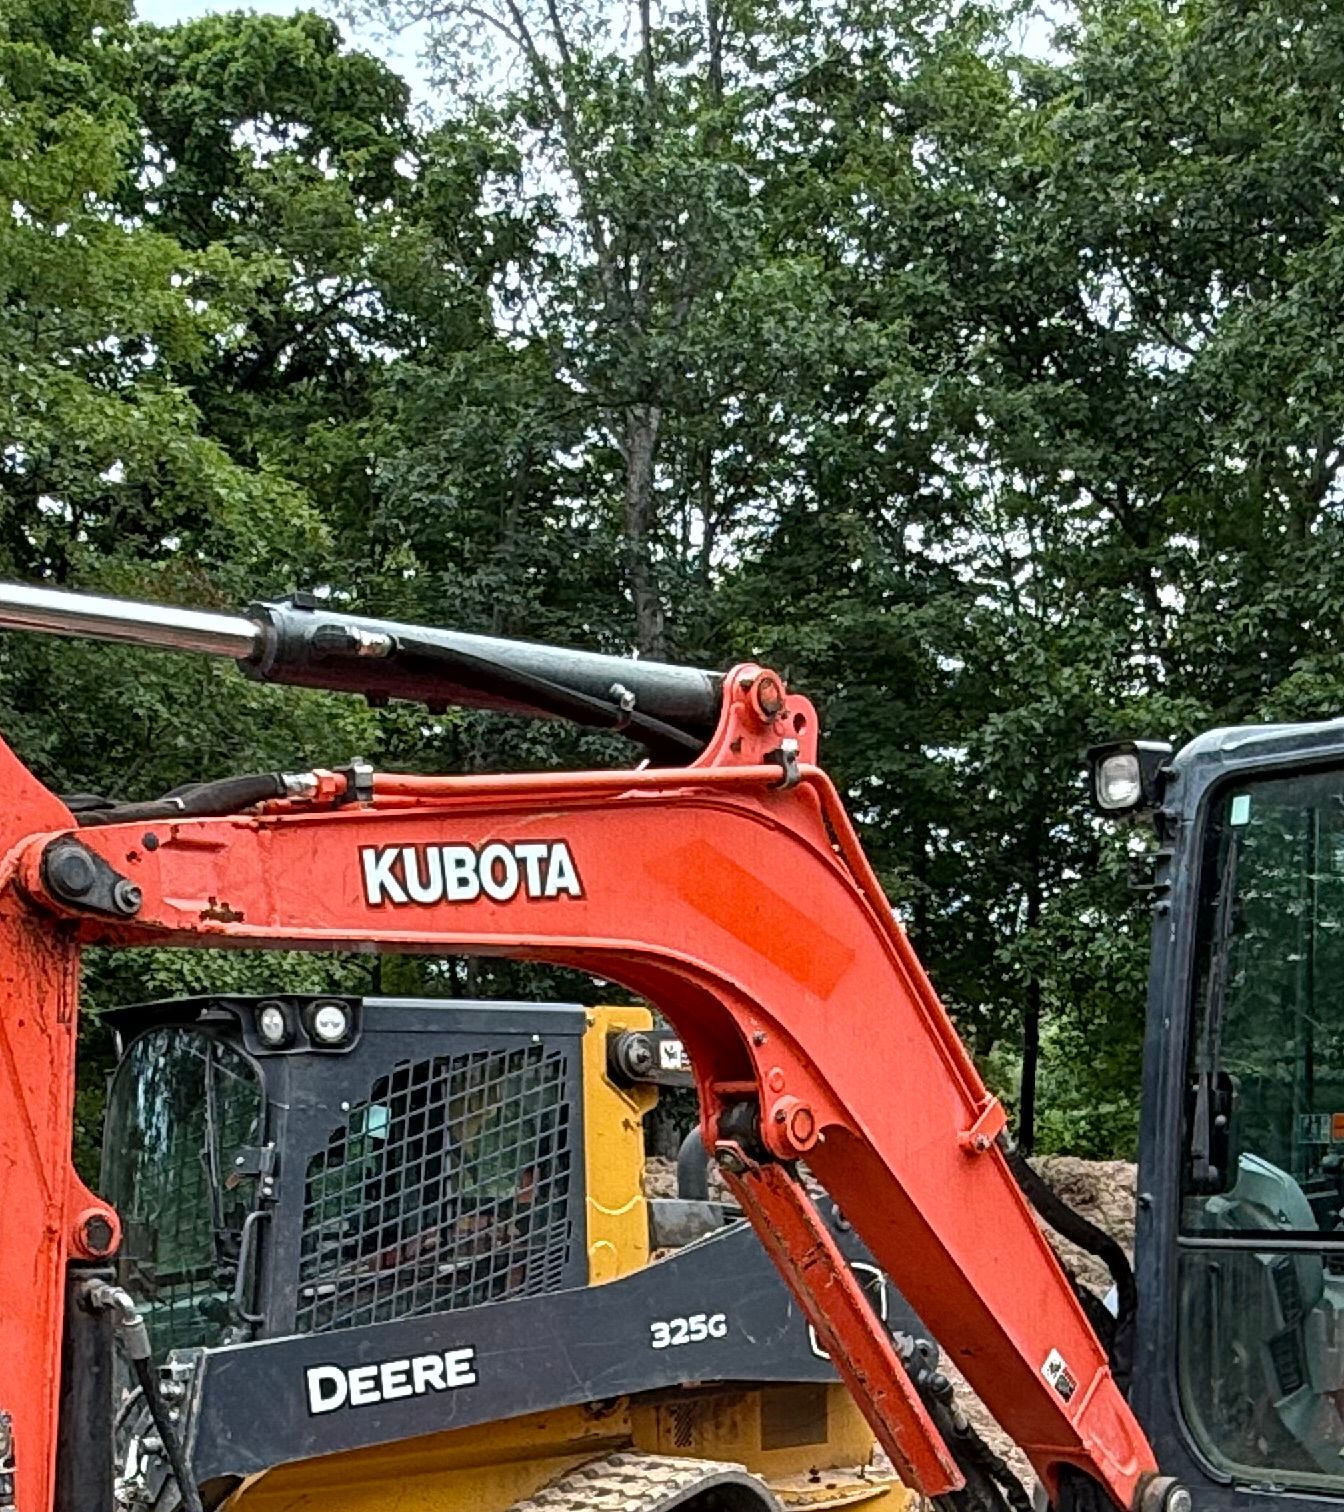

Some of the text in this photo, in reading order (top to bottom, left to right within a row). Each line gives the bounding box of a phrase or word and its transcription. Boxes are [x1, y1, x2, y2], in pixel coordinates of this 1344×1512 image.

[361, 841, 583, 905] KUBOTA
[650, 1313, 728, 1348] 325G
[306, 1347, 477, 1414] DEERE
